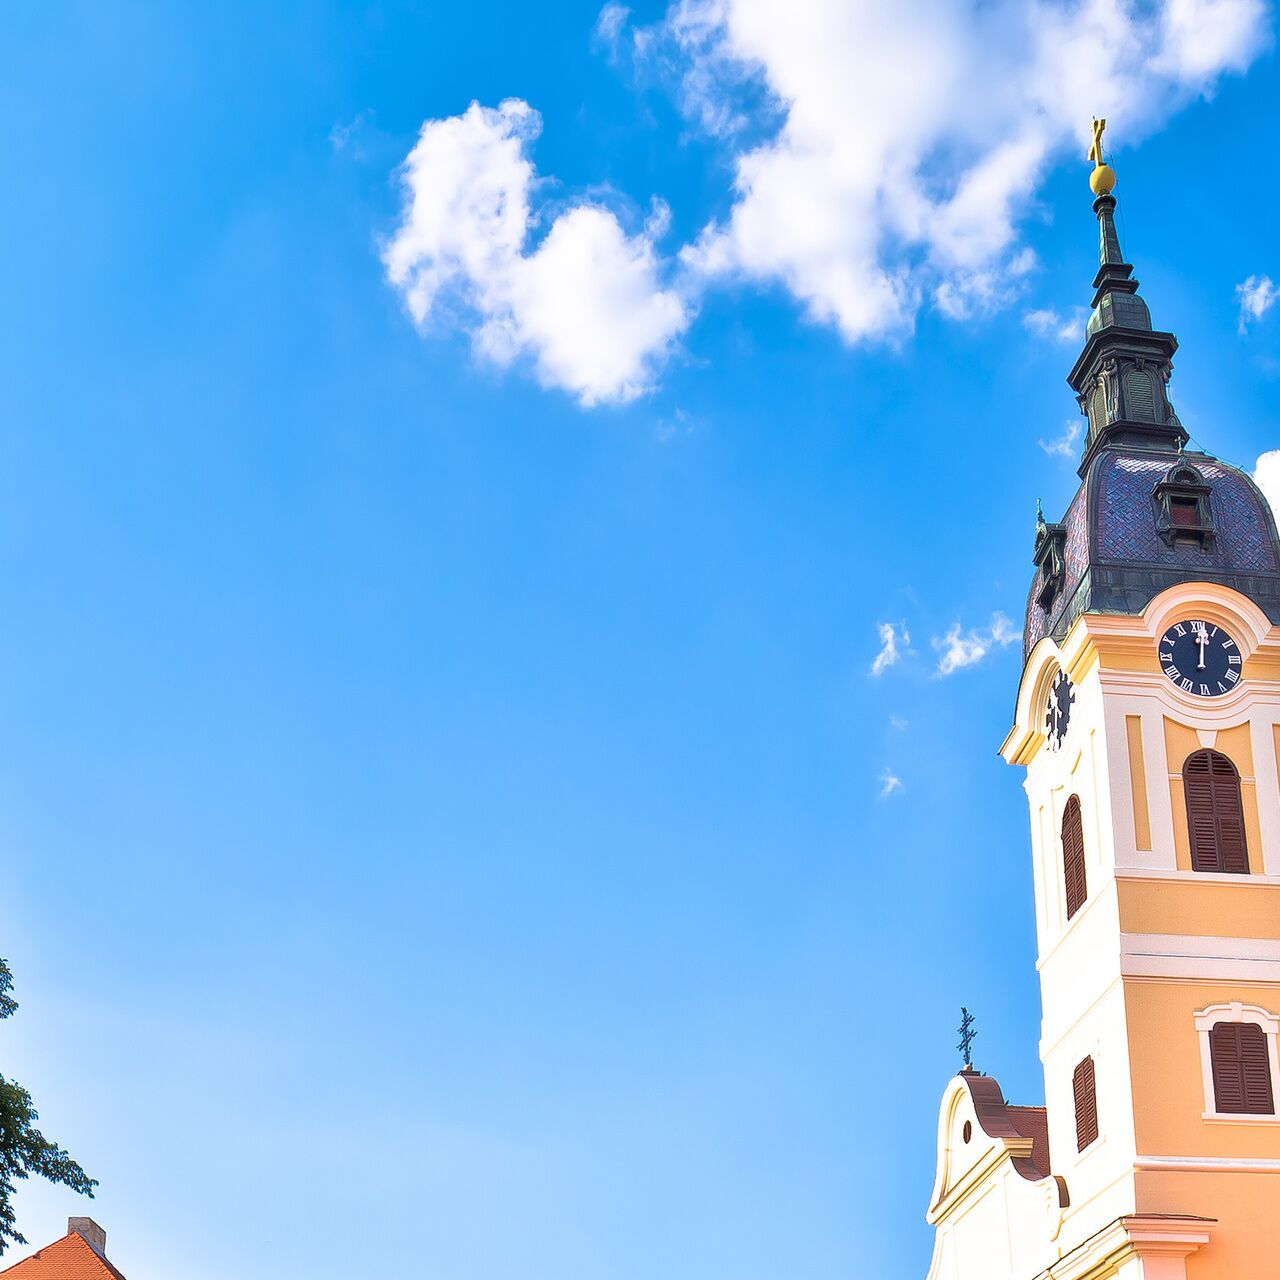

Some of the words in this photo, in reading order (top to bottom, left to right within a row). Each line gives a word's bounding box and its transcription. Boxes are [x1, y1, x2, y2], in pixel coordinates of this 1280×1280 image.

[1173, 623, 1187, 637] XI
[1211, 626, 1218, 637] I
[1162, 635, 1175, 647] X
[1222, 639, 1234, 649] II
[1160, 652, 1172, 662] IX
[1228, 655, 1241, 664] III
[1164, 665, 1181, 681] VIII
[1224, 668, 1239, 683] IIII
[1180, 677, 1193, 692] VII
[1200, 684, 1210, 695] VI
[1217, 681, 1227, 693] V
